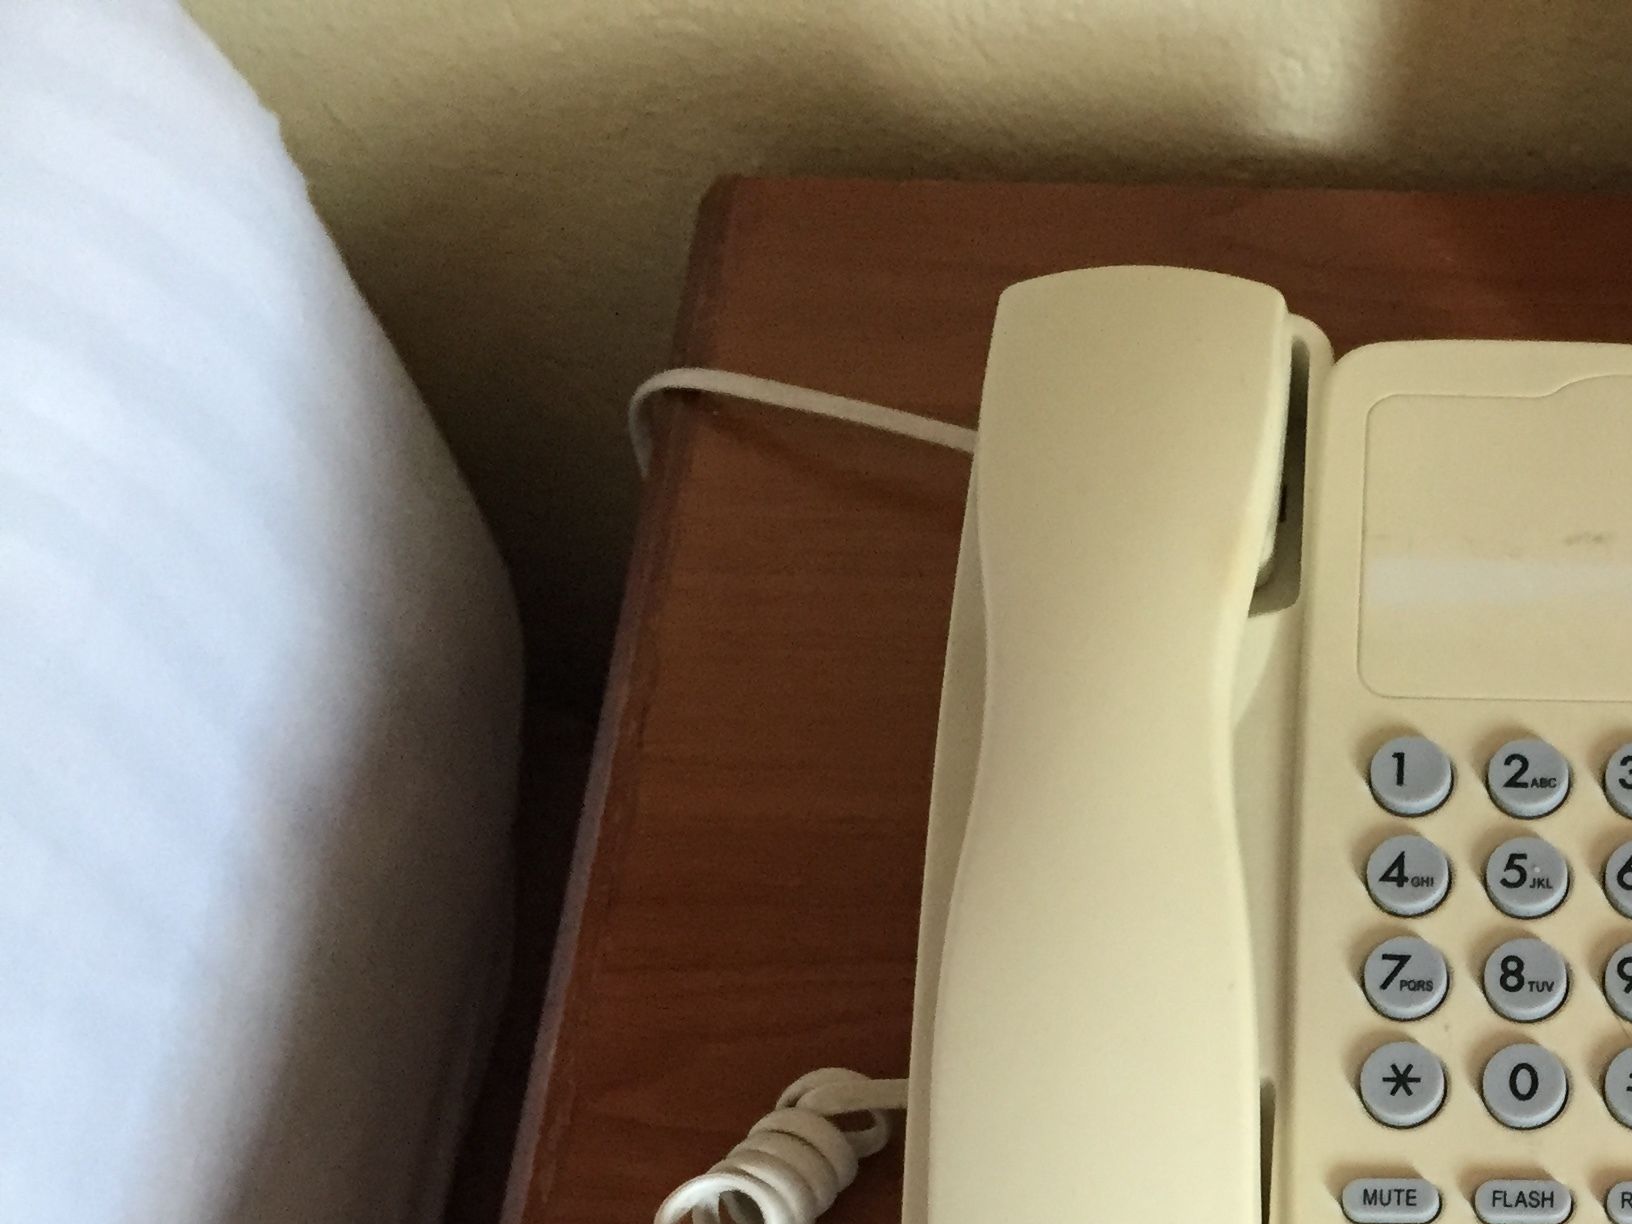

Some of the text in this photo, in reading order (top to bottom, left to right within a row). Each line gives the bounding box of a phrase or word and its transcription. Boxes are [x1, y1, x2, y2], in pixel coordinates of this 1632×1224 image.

[1391, 751, 1405, 786] 1
[1503, 753, 1557, 789] 2 ABC
[1379, 850, 1434, 888] 4 GHI
[1500, 853, 1553, 890] 5 JKL
[1379, 953, 1434, 992] 7 PQRS
[1499, 954, 1555, 993] 8 TUV
[1509, 1062, 1539, 1101] 0
[1362, 1188, 1418, 1207] MUTE
[1491, 1191, 1555, 1208] FLASH
